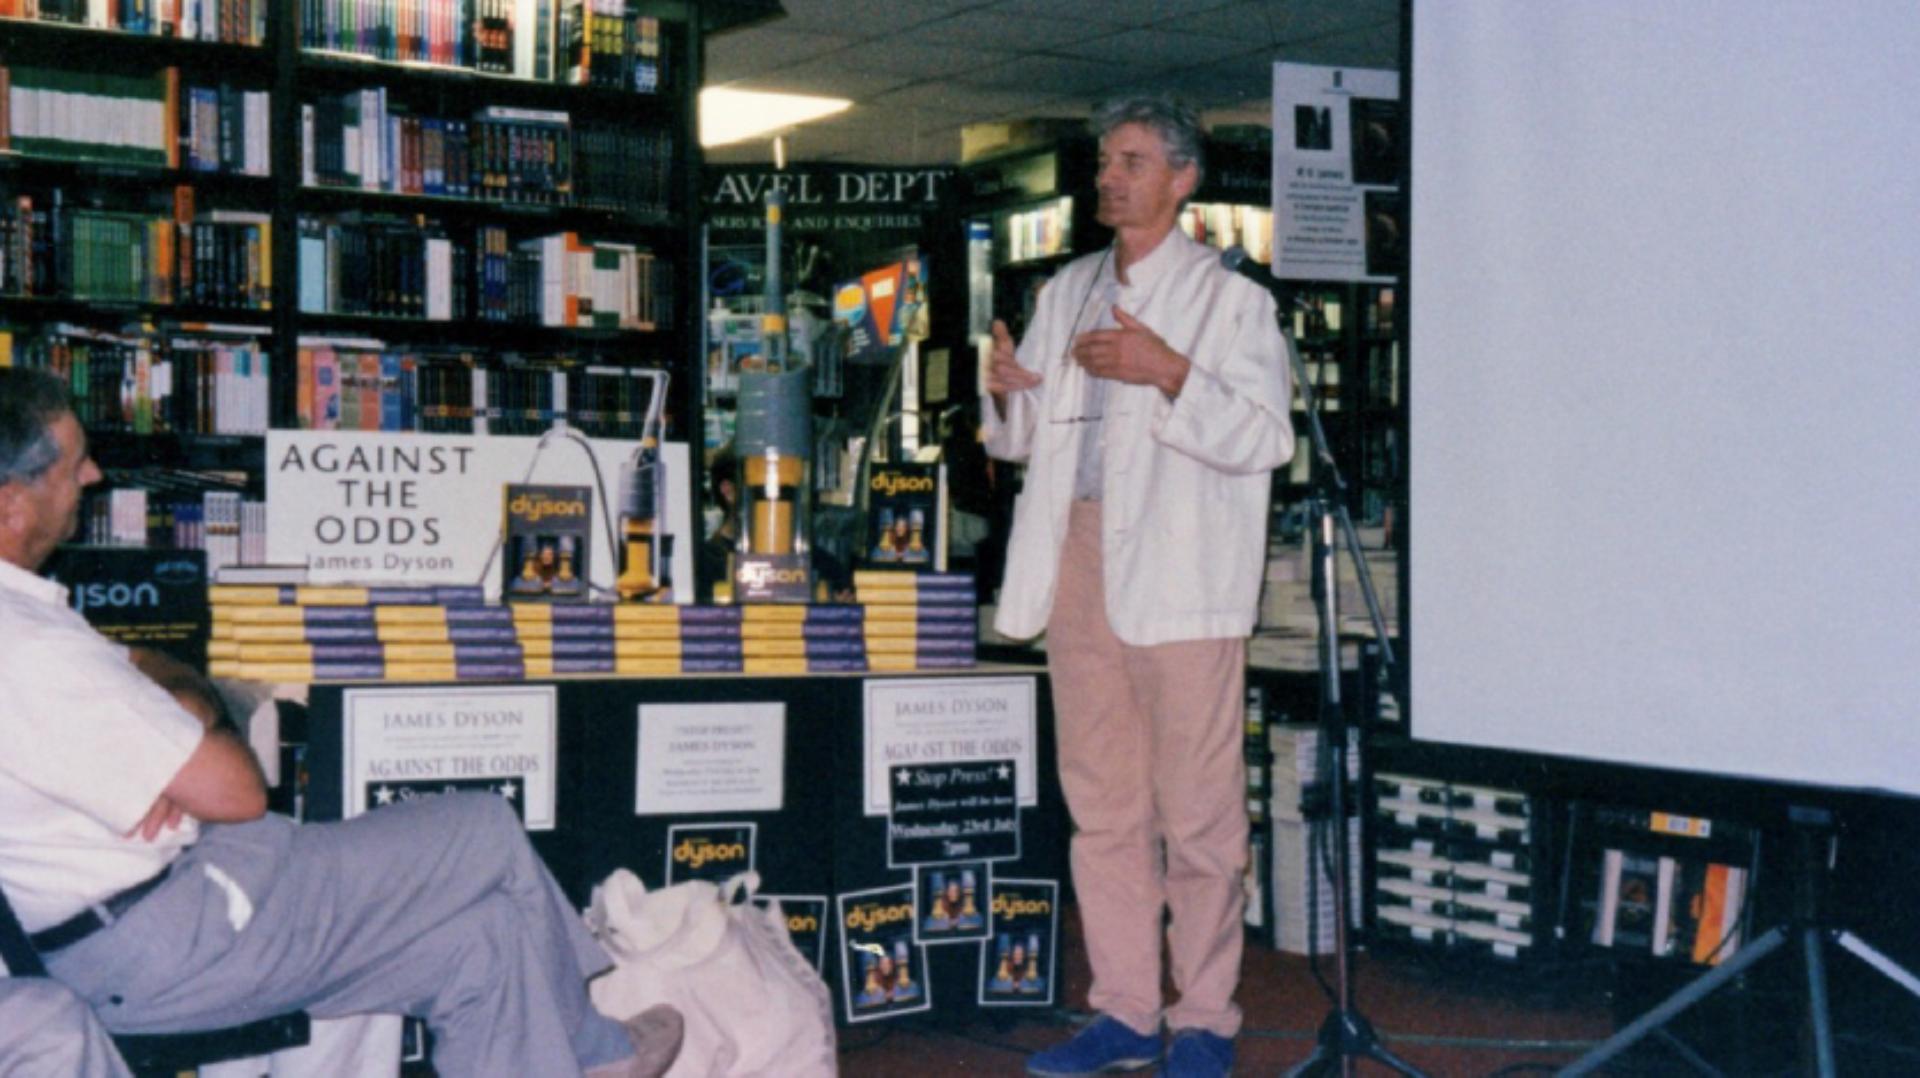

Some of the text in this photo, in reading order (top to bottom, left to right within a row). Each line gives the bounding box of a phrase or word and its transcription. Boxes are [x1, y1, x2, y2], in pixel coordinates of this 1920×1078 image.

[713, 173, 823, 203] AVEL
[279, 444, 474, 473] AGAINST
[338, 479, 419, 508] THE
[871, 472, 933, 496] dyson
[511, 495, 585, 521] dyson
[314, 515, 442, 546] ODDS
[383, 552, 454, 575] Dyson
[75, 582, 159, 612] yson
[382, 709, 524, 729] JAMES DYSON
[895, 697, 1008, 717] JAMES DYSON
[366, 753, 540, 777] AGAINST THE ODDS
[913, 770, 946, 790] Stop
[673, 840, 745, 868] dyson
[846, 904, 913, 932] dyson
[991, 893, 1051, 920] dyson
